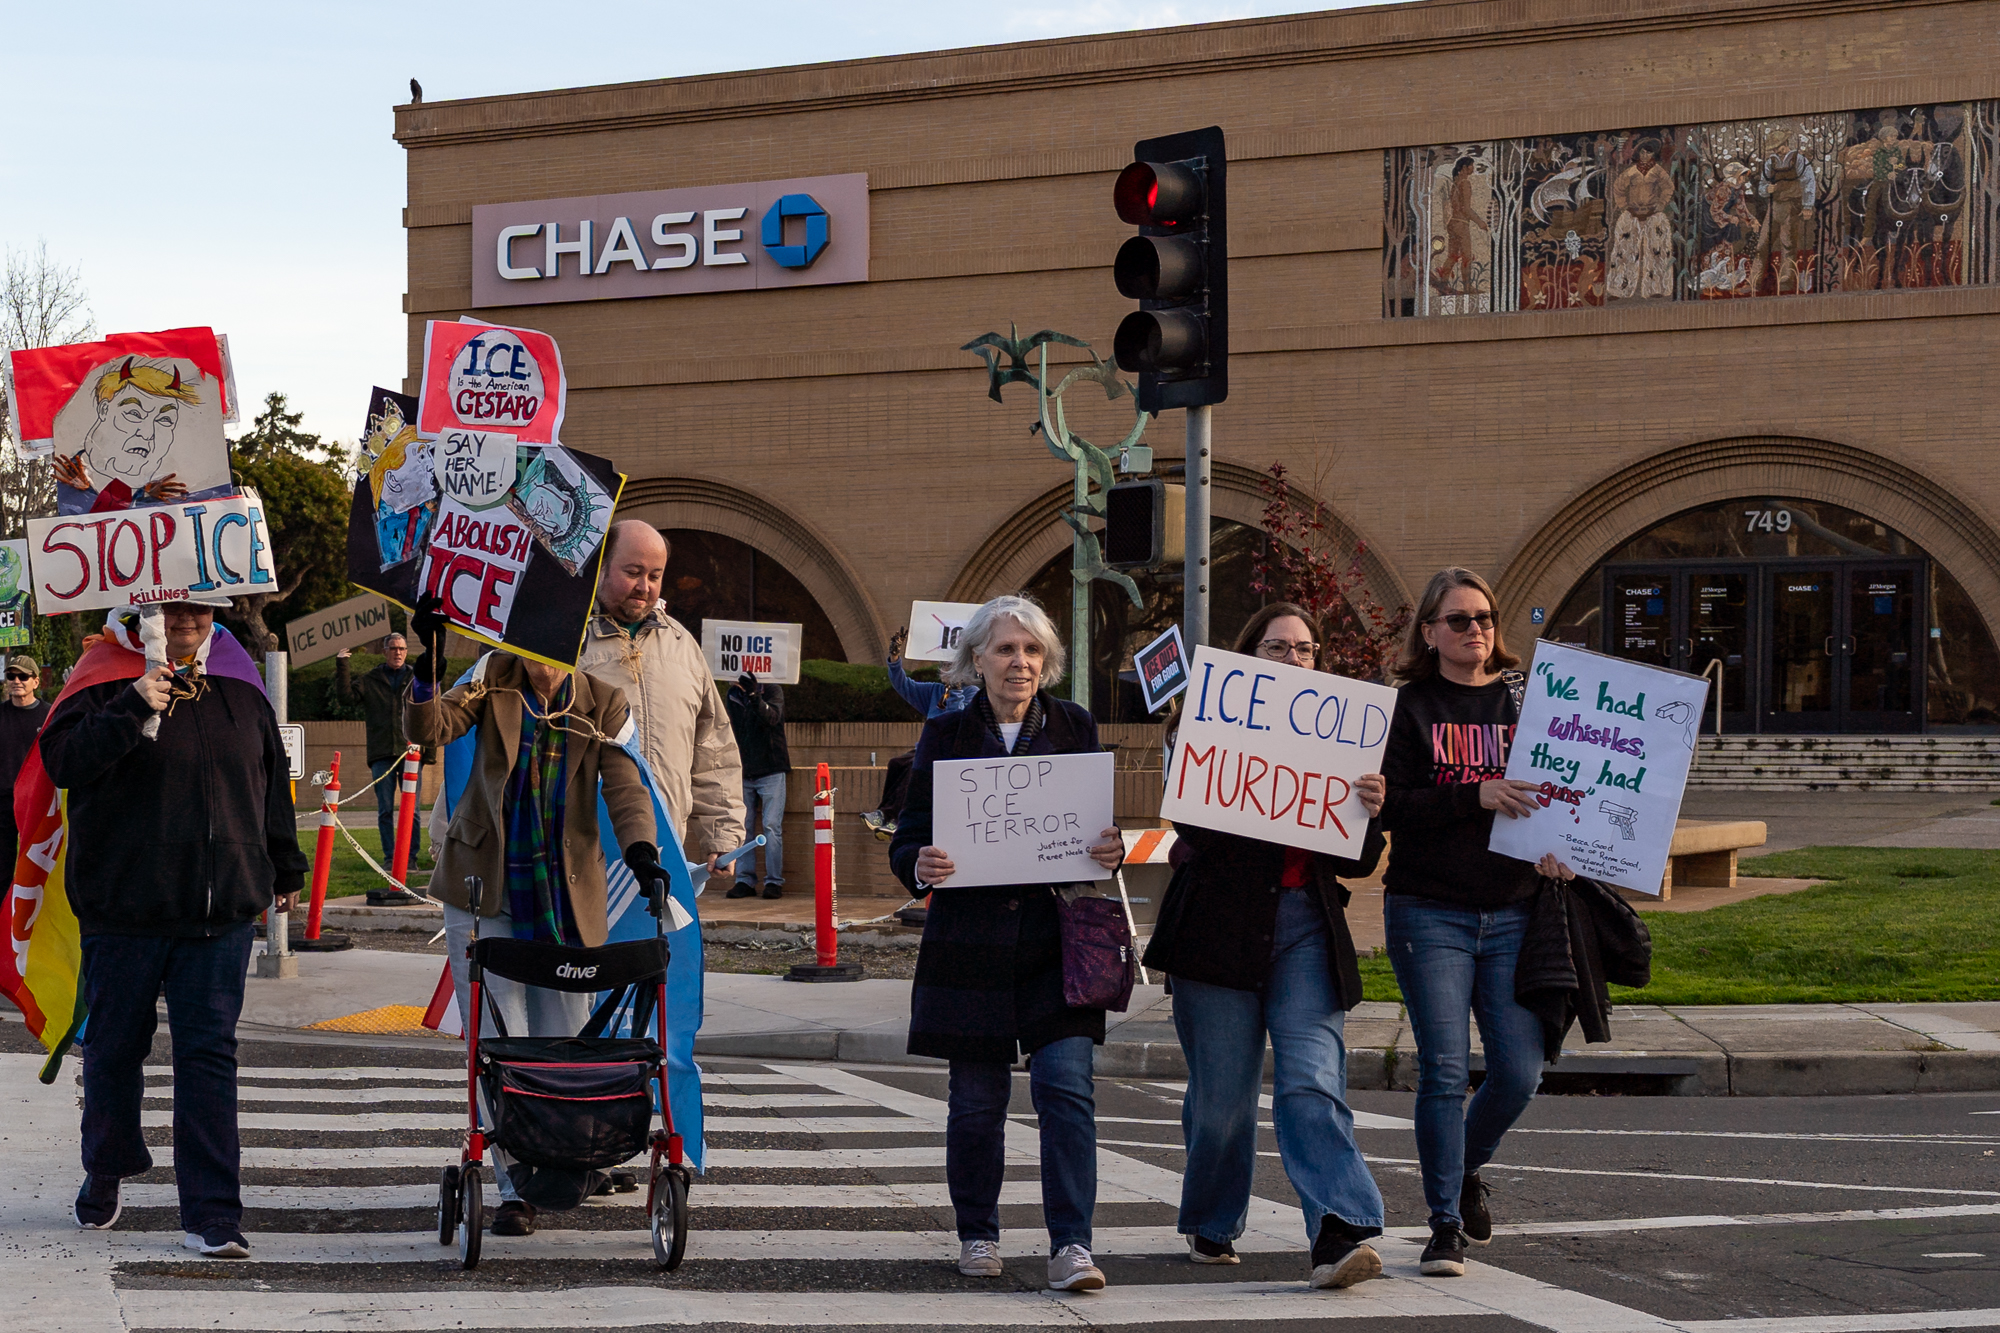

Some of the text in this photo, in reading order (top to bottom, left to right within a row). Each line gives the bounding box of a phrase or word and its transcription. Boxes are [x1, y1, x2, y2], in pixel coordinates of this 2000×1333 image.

[496, 207, 749, 280] CHASE
[463, 339, 531, 380] I.C.E.
[468, 377, 482, 388] the
[485, 378, 530, 392] American
[456, 389, 539, 421] GESTAPO
[444, 433, 487, 457] SAY
[445, 457, 480, 472] HER
[445, 457, 506, 497] NAME!
[1745, 510, 1792, 533] 749
[433, 511, 532, 563] ABOLISH
[42, 504, 275, 600] STOP I.C.E.
[1625, 588, 1653, 596] CHASE
[292, 603, 386, 653] ICE OUT NOW
[941, 626, 964, 650] IC
[721, 634, 773, 653] NO ICE
[721, 654, 772, 672] NO WAR
[1146, 644, 1176, 677] ICE OUT
[1150, 661, 1179, 691] FOR GOOD
[1195, 662, 1388, 748] I.C.E. COLD
[1596, 681, 1646, 721] had
[960, 760, 1052, 793] STOP
[1530, 742, 1647, 793] they had
[1177, 742, 1349, 840] MURDER
[967, 792, 1022, 820] ICE
[966, 812, 1081, 844] TERROR
[1037, 837, 1083, 852] Justice for
[1037, 854, 1063, 862] Renee
[1571, 845, 1585, 853] wife
[1620, 857, 1642, 871] Good,
[1592, 840, 1614, 852] Good
[1571, 855, 1628, 875] murdered mom
[1587, 866, 1617, 878] neighbor
[556, 962, 598, 979] drive
